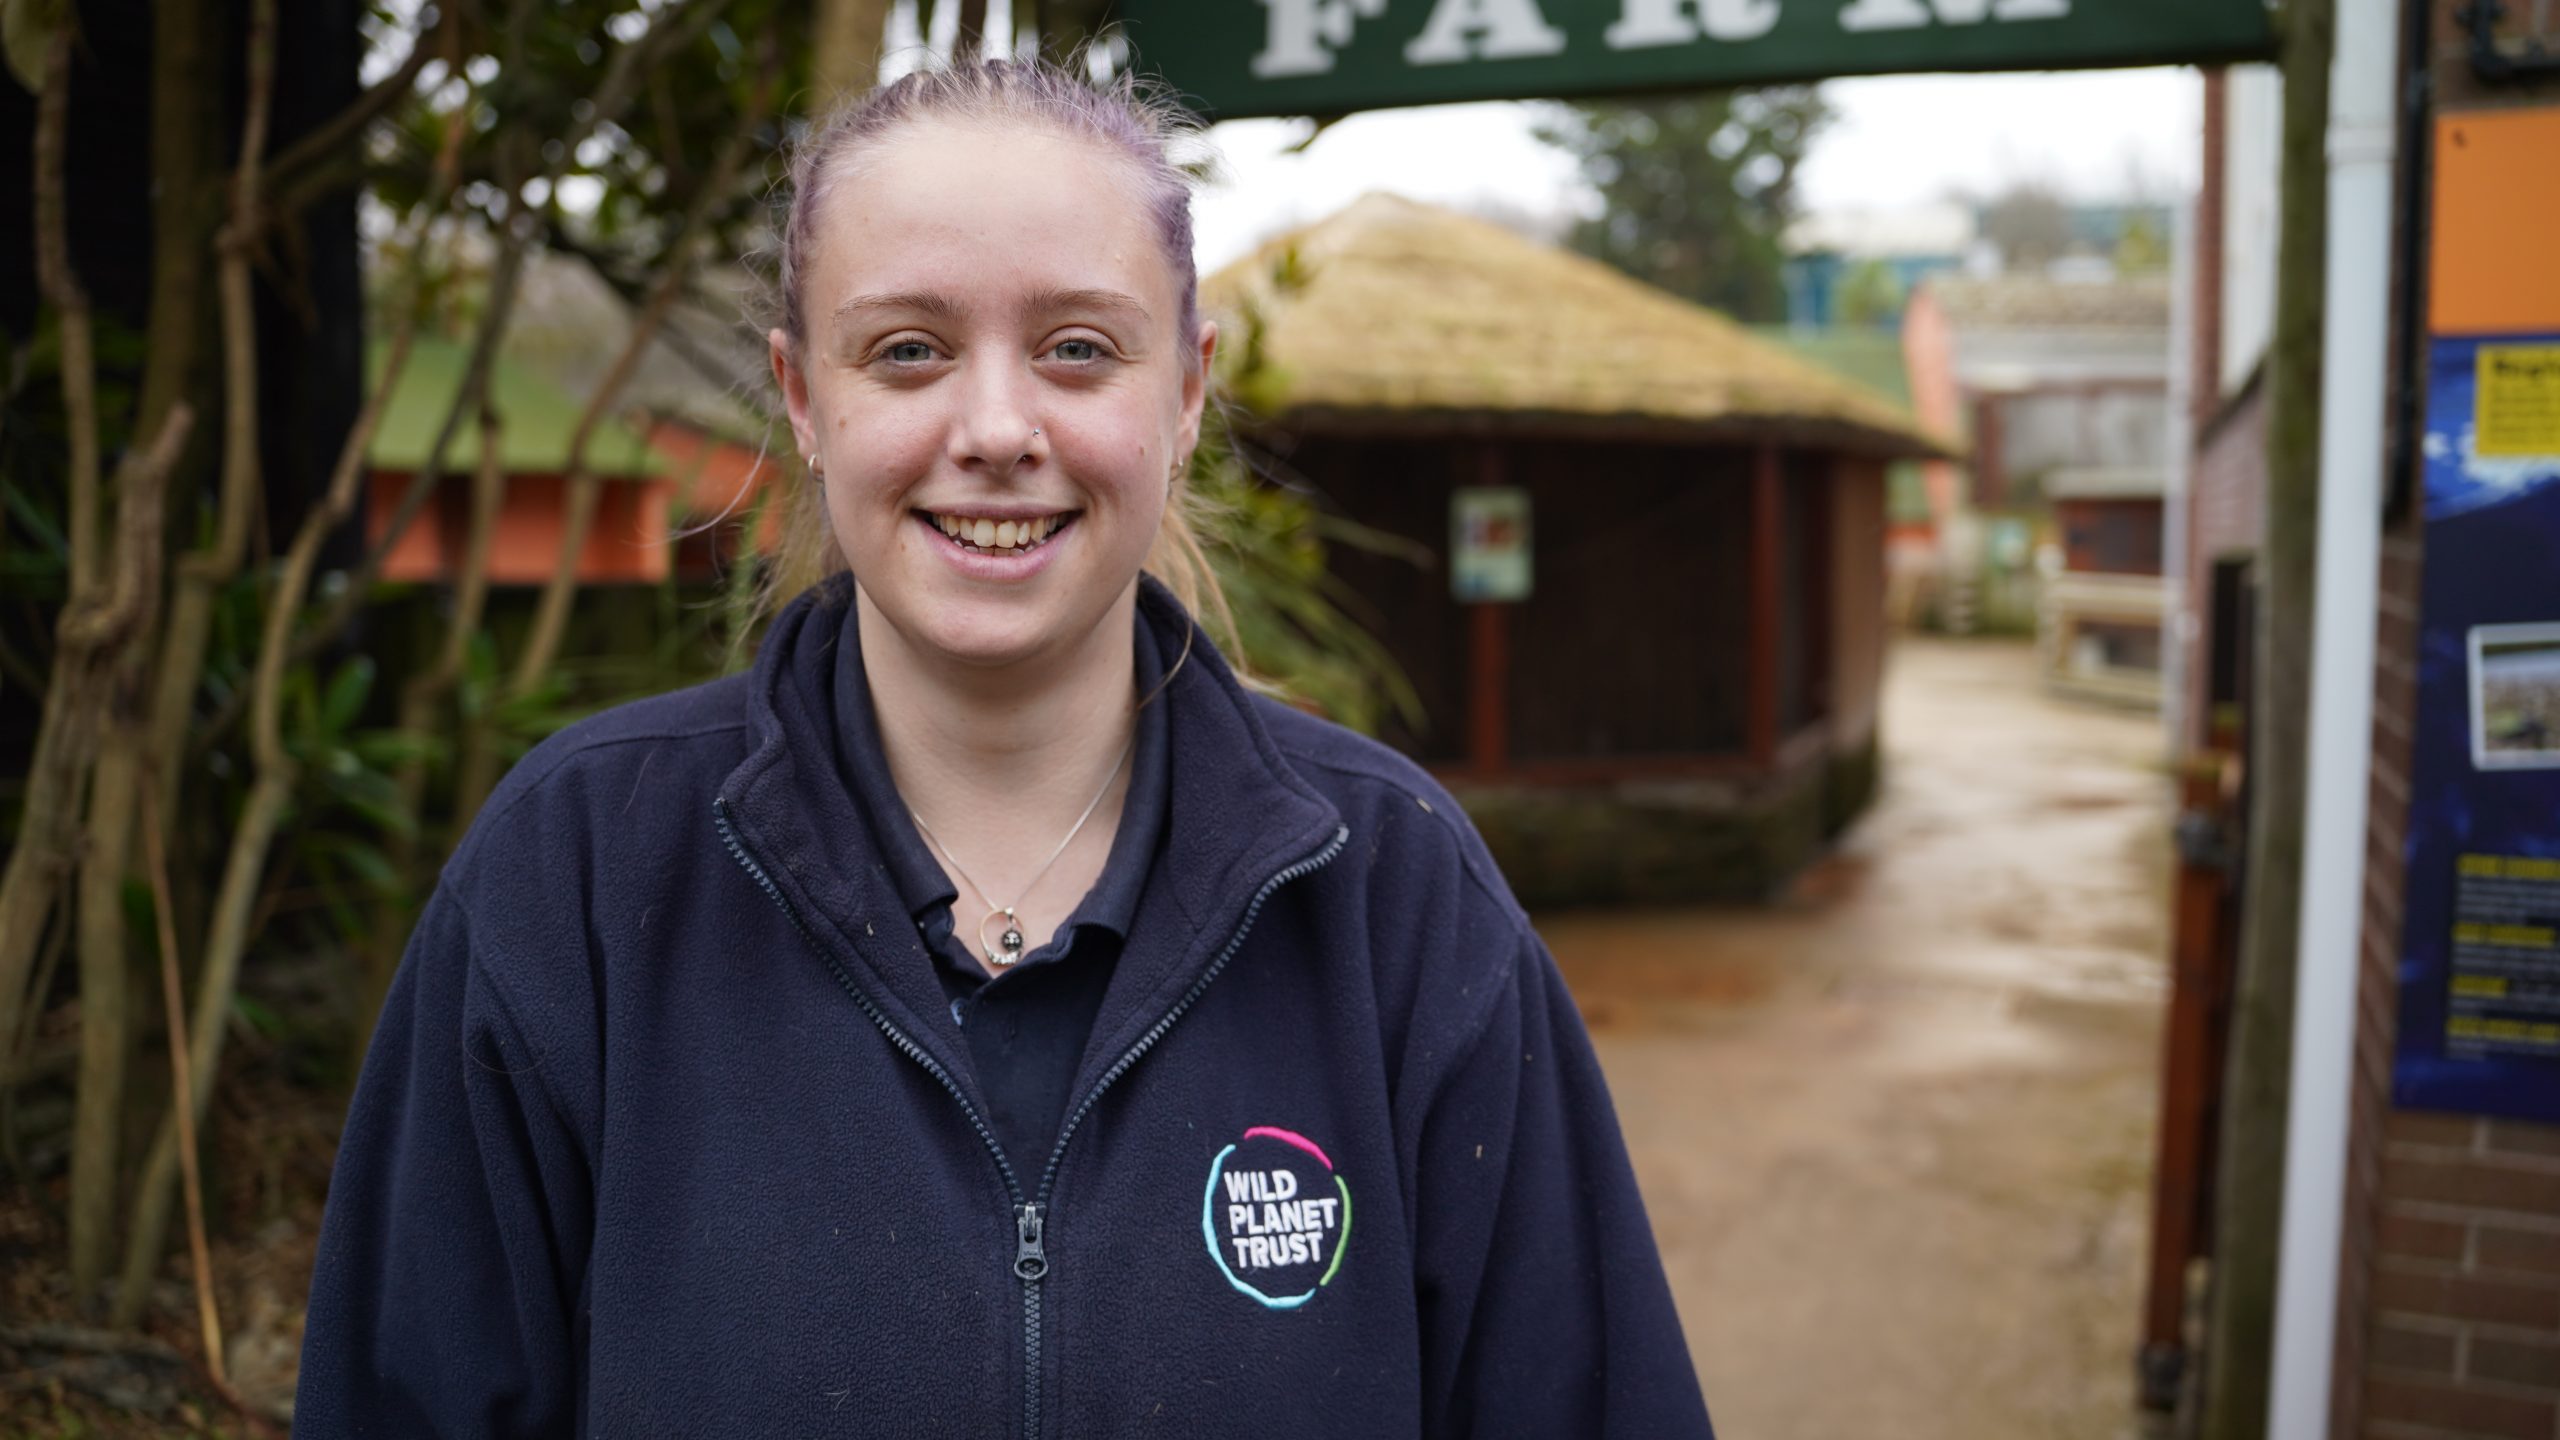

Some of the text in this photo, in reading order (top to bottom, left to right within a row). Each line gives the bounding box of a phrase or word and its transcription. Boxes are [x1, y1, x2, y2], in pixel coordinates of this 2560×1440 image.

[1252, 0, 2071, 79] FA
[1224, 1170, 1298, 1202] WILD
[1229, 1198, 1338, 1235] PLANET
[1232, 1232, 1323, 1268] TRUST
